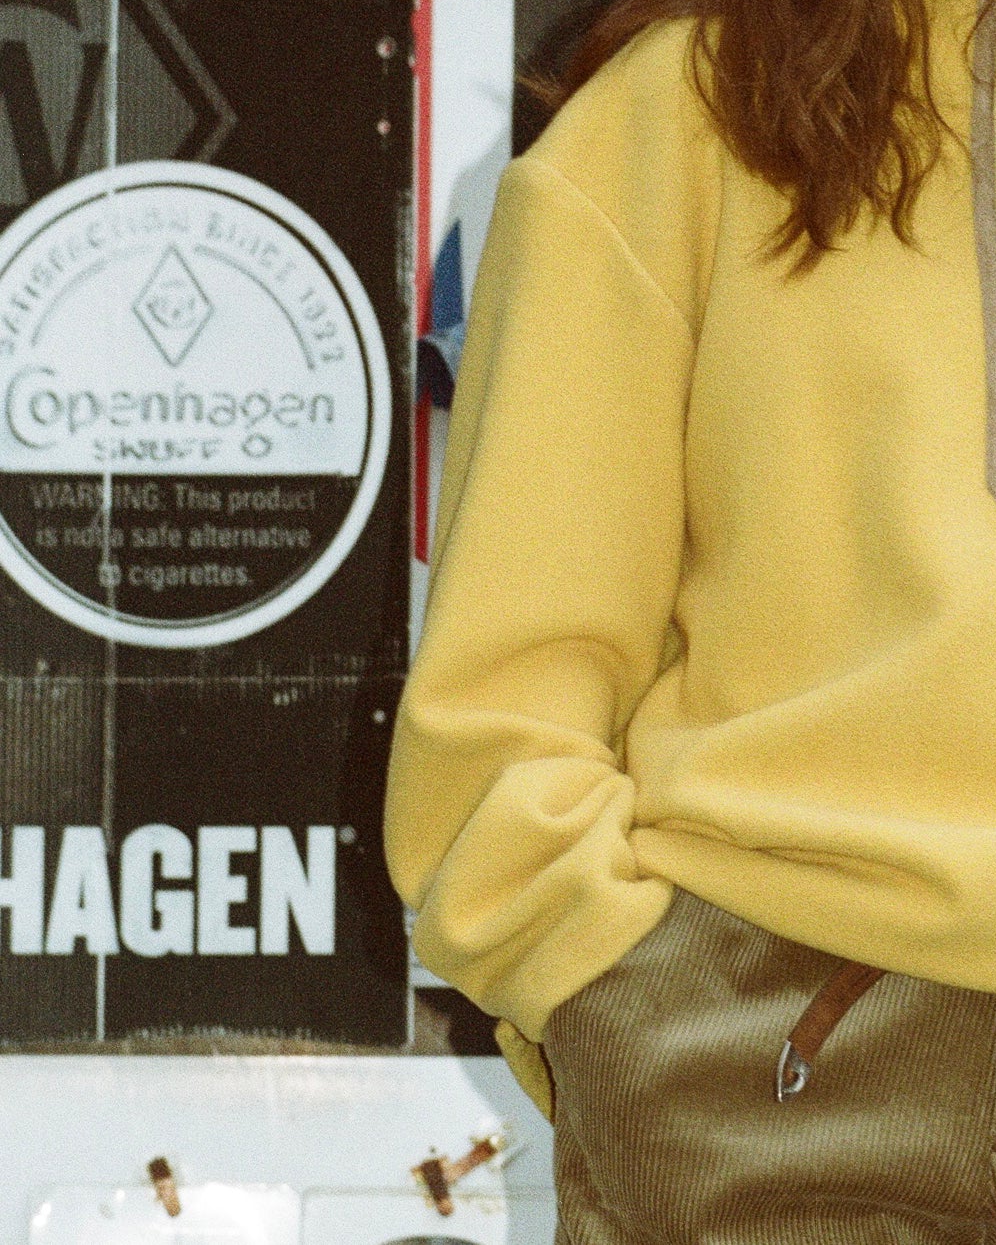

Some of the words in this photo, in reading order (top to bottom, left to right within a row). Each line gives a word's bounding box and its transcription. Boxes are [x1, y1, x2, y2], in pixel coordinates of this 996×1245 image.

[5, 365, 336, 458] Copenhagen
[132, 522, 182, 549] safe
[188, 524, 310, 550] alternative
